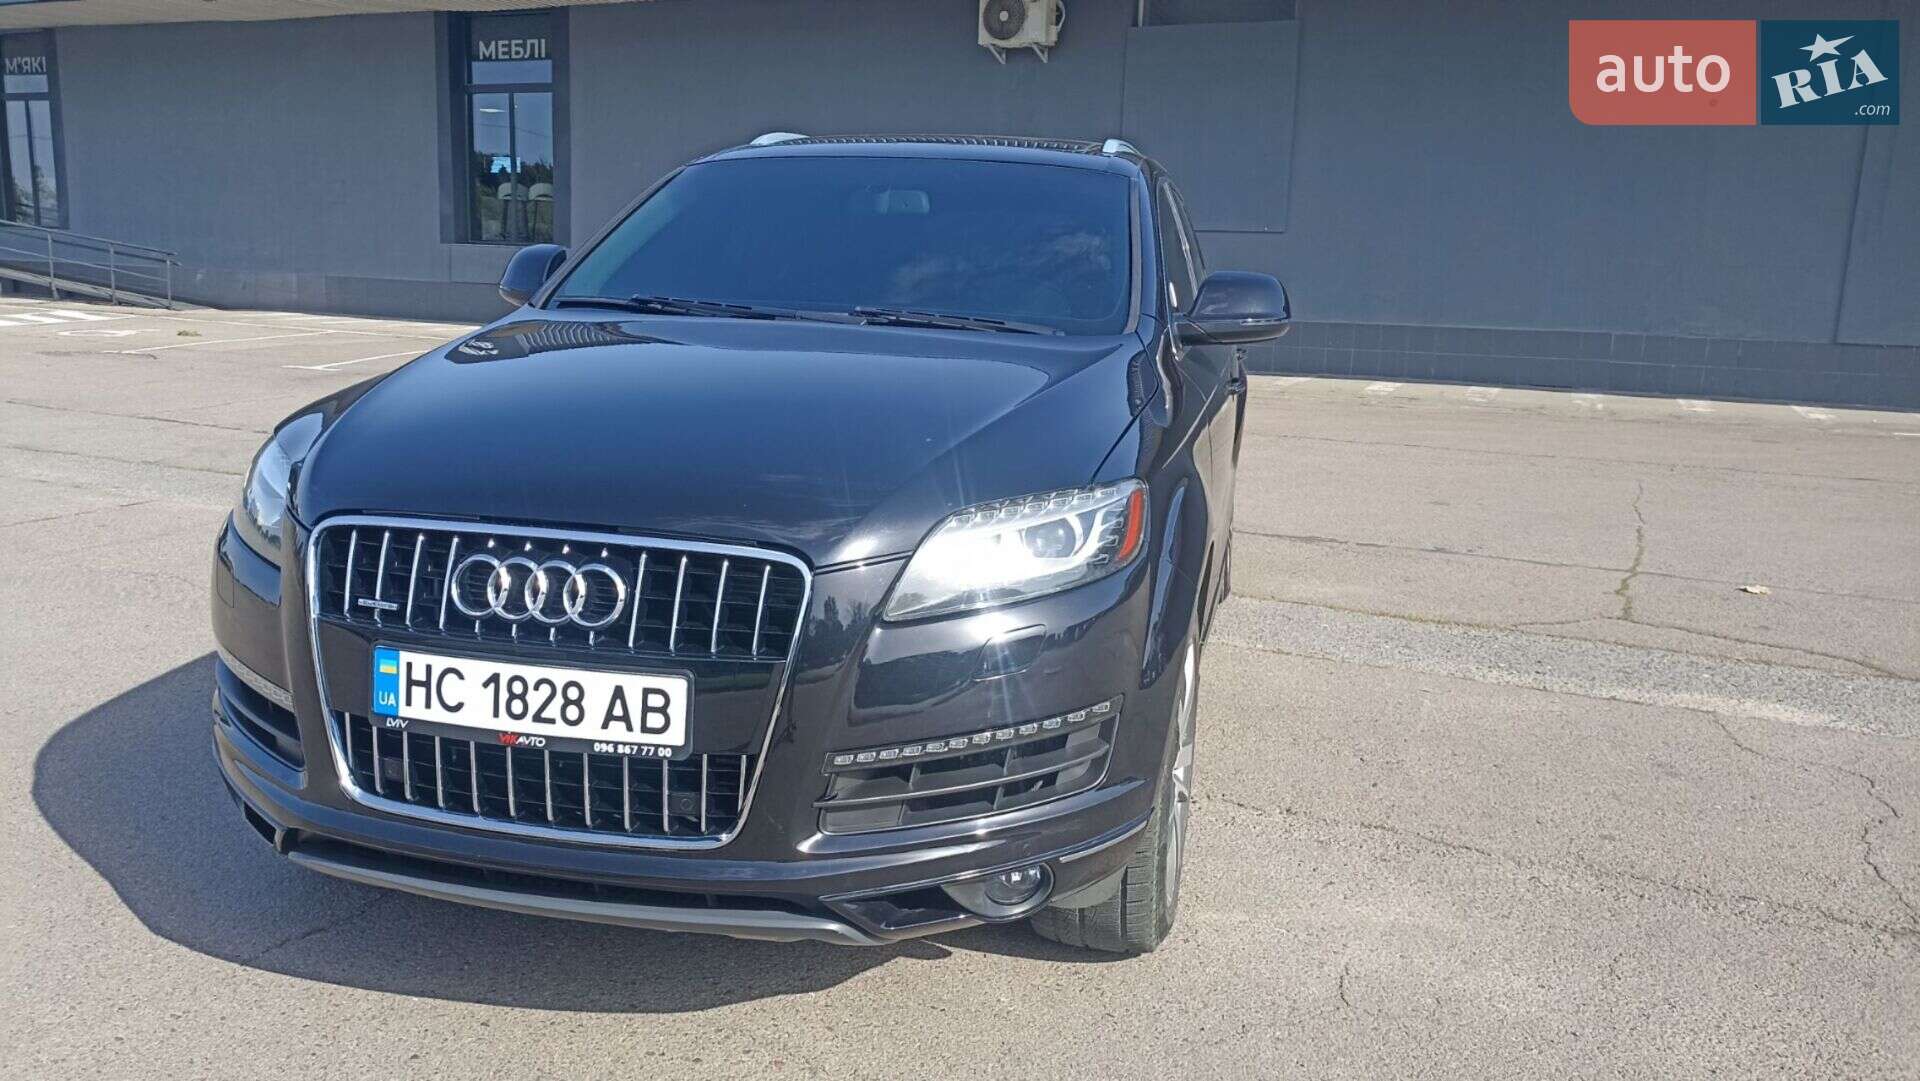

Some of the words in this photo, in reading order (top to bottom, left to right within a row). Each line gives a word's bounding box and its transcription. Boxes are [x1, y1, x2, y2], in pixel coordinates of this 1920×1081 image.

[478, 38, 547, 60] МЕБЛІ
[379, 691, 397, 707] UA
[405, 661, 465, 713] HC
[482, 672, 586, 727] 1828
[600, 685, 672, 735] AB
[386, 717, 409, 729] LVIV
[593, 742, 614, 753] 096
[617, 744, 638, 755] 867
[641, 745, 655, 756] 77
[658, 747, 672, 757] 00
